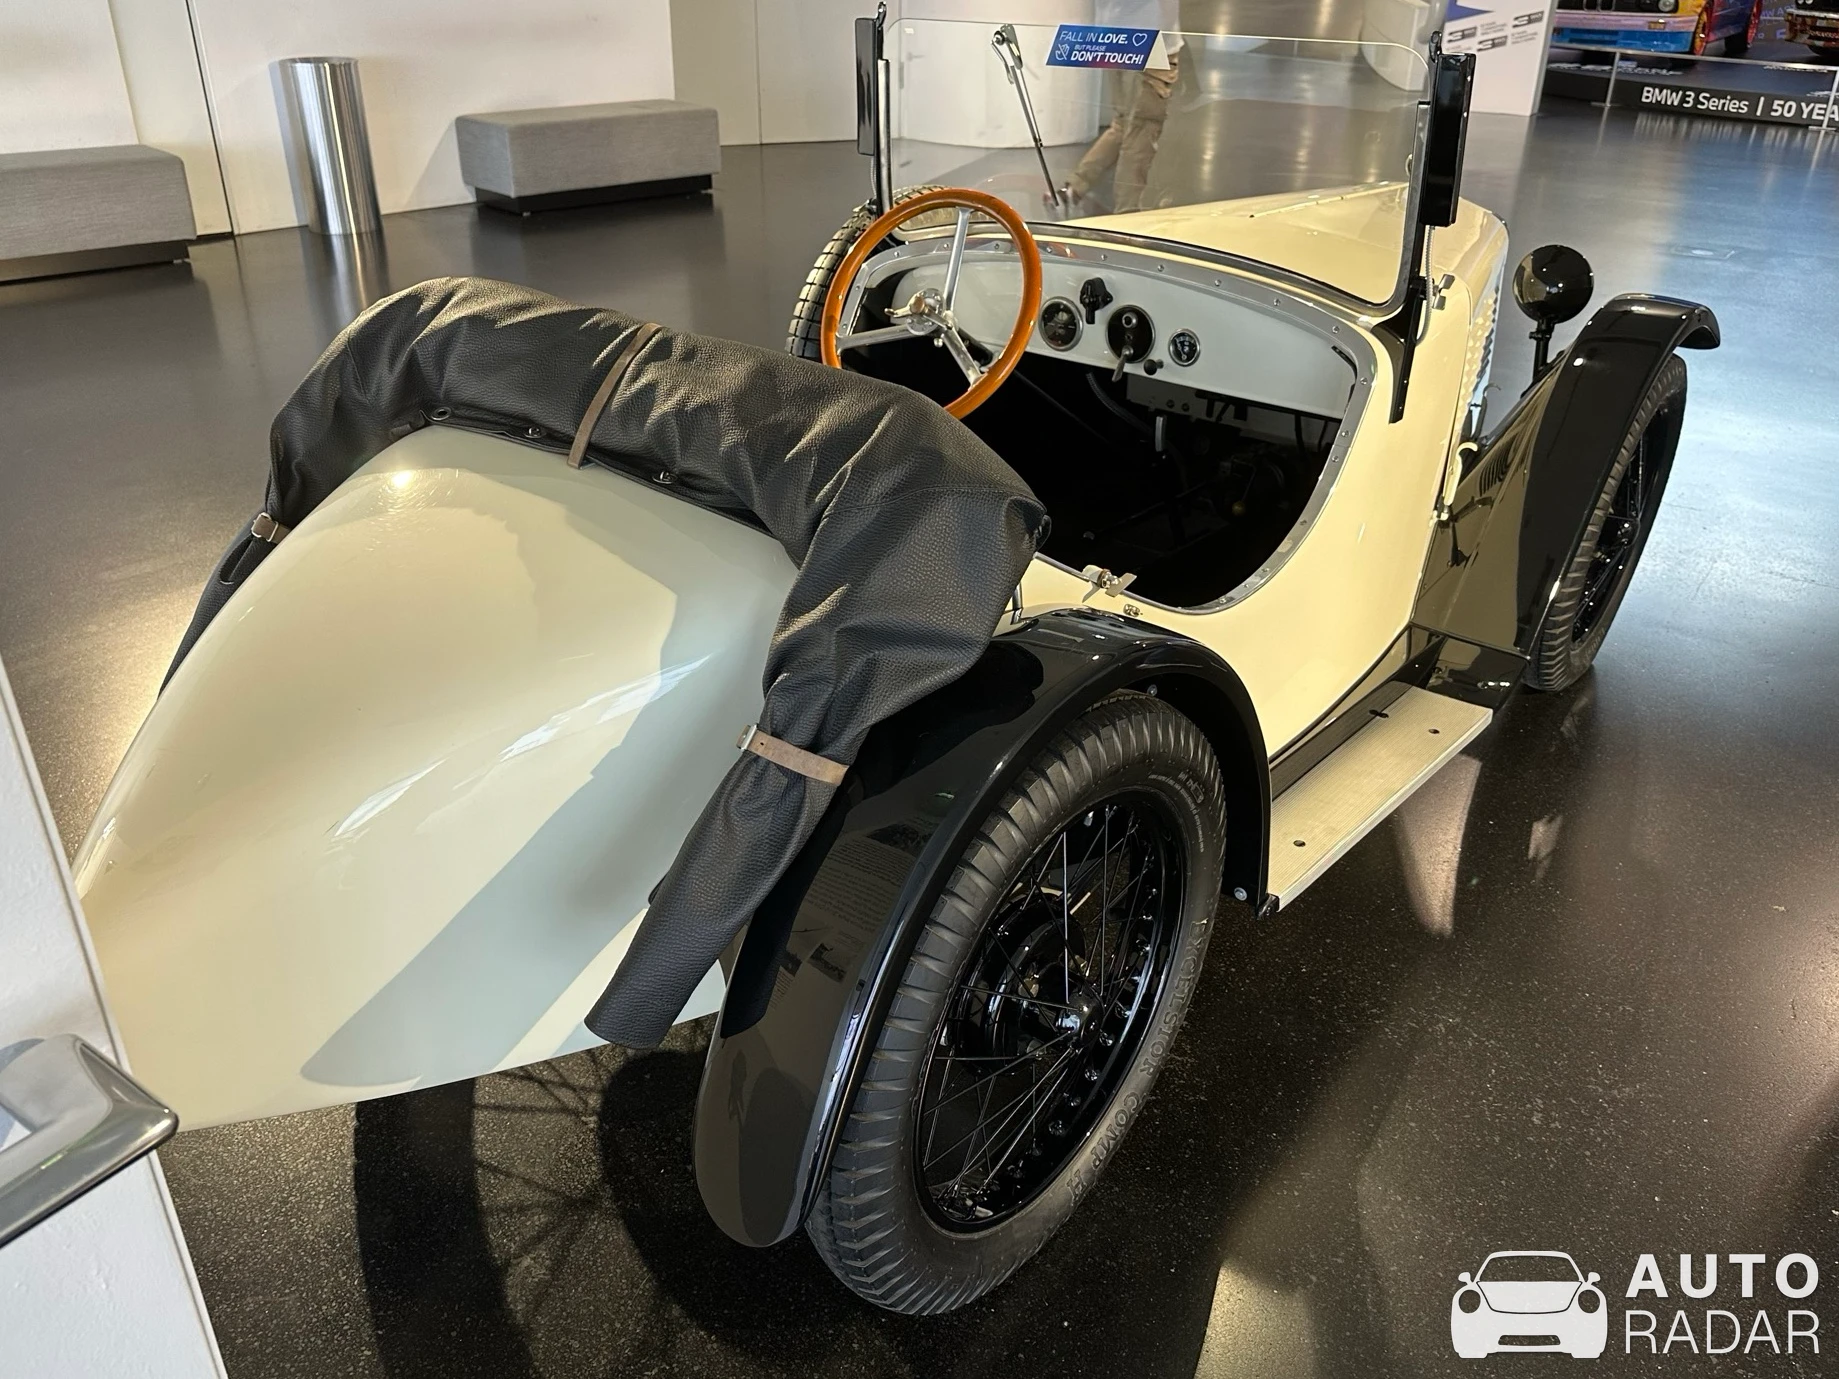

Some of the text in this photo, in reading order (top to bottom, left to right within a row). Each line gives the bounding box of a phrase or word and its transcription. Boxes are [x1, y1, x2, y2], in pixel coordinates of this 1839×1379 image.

[1059, 30, 1129, 45] FALL IN LOVE.
[1086, 44, 1107, 52] PLEASE
[1070, 51, 1145, 65] DON'T TOUCH!
[1641, 86, 1683, 106] BMW
[1682, 91, 1695, 108] 3
[1697, 92, 1749, 114] Series
[1770, 100, 1797, 118] 50
[1092, 1092, 1140, 1169] COMP
[1066, 1170, 1087, 1201] H
